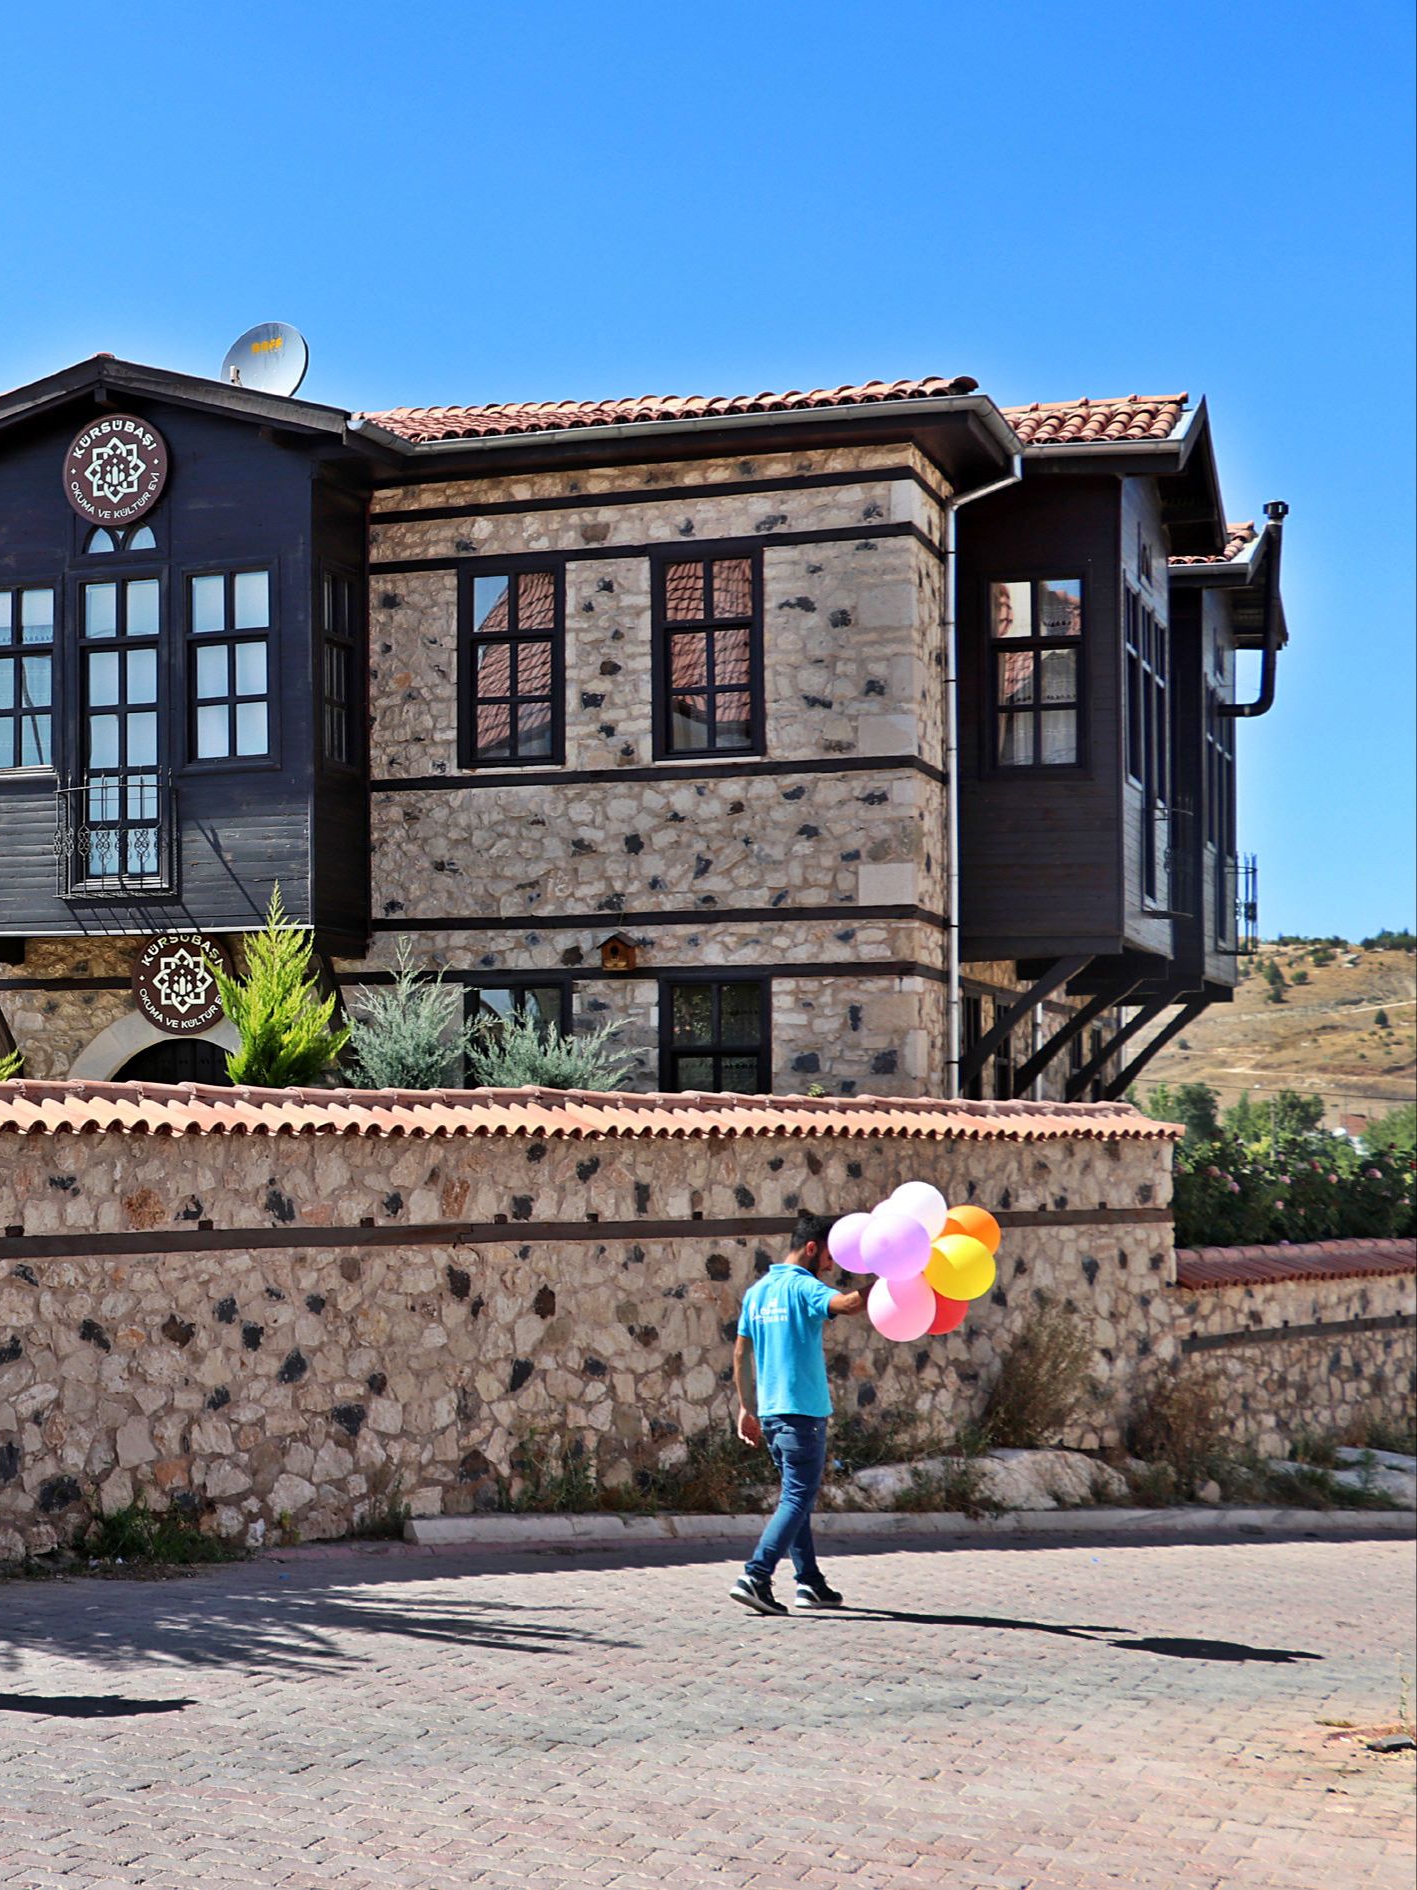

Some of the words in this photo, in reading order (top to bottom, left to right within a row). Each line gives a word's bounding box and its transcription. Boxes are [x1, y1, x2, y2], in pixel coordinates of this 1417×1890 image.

[73, 420, 157, 459] KÜRSÜBAŞI
[71, 482, 95, 515] OKUMA
[97, 509, 112, 519] VE
[114, 491, 152, 519] KÜLTÜR
[148, 472, 160, 491] EVİ
[139, 988, 164, 1023] OKUMA
[165, 1017, 179, 1029] VE
[181, 1004, 219, 1029] KÜLTÜR
